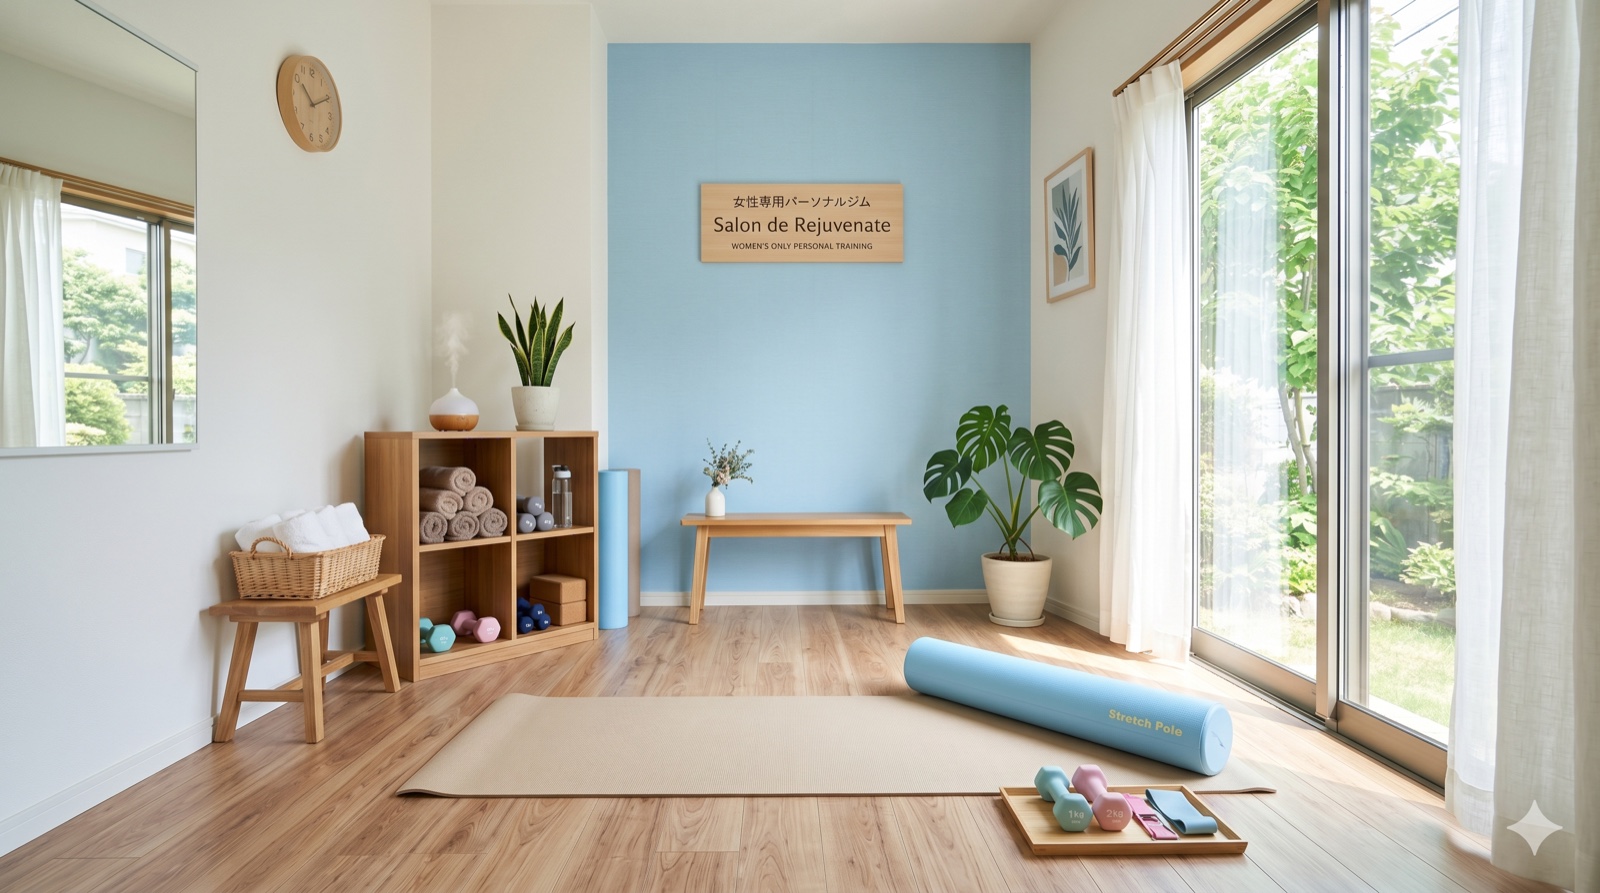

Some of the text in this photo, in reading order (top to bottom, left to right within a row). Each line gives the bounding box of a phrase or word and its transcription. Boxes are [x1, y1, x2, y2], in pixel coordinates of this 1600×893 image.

[732, 195, 871, 209] 女性専用パーソナルジム
[713, 216, 891, 237] Salon de Rejuvenate
[731, 242, 873, 250] WOMEN'S ONLY PERSONAL TRAINING
[1108, 708, 1183, 737] Stretch Pole
